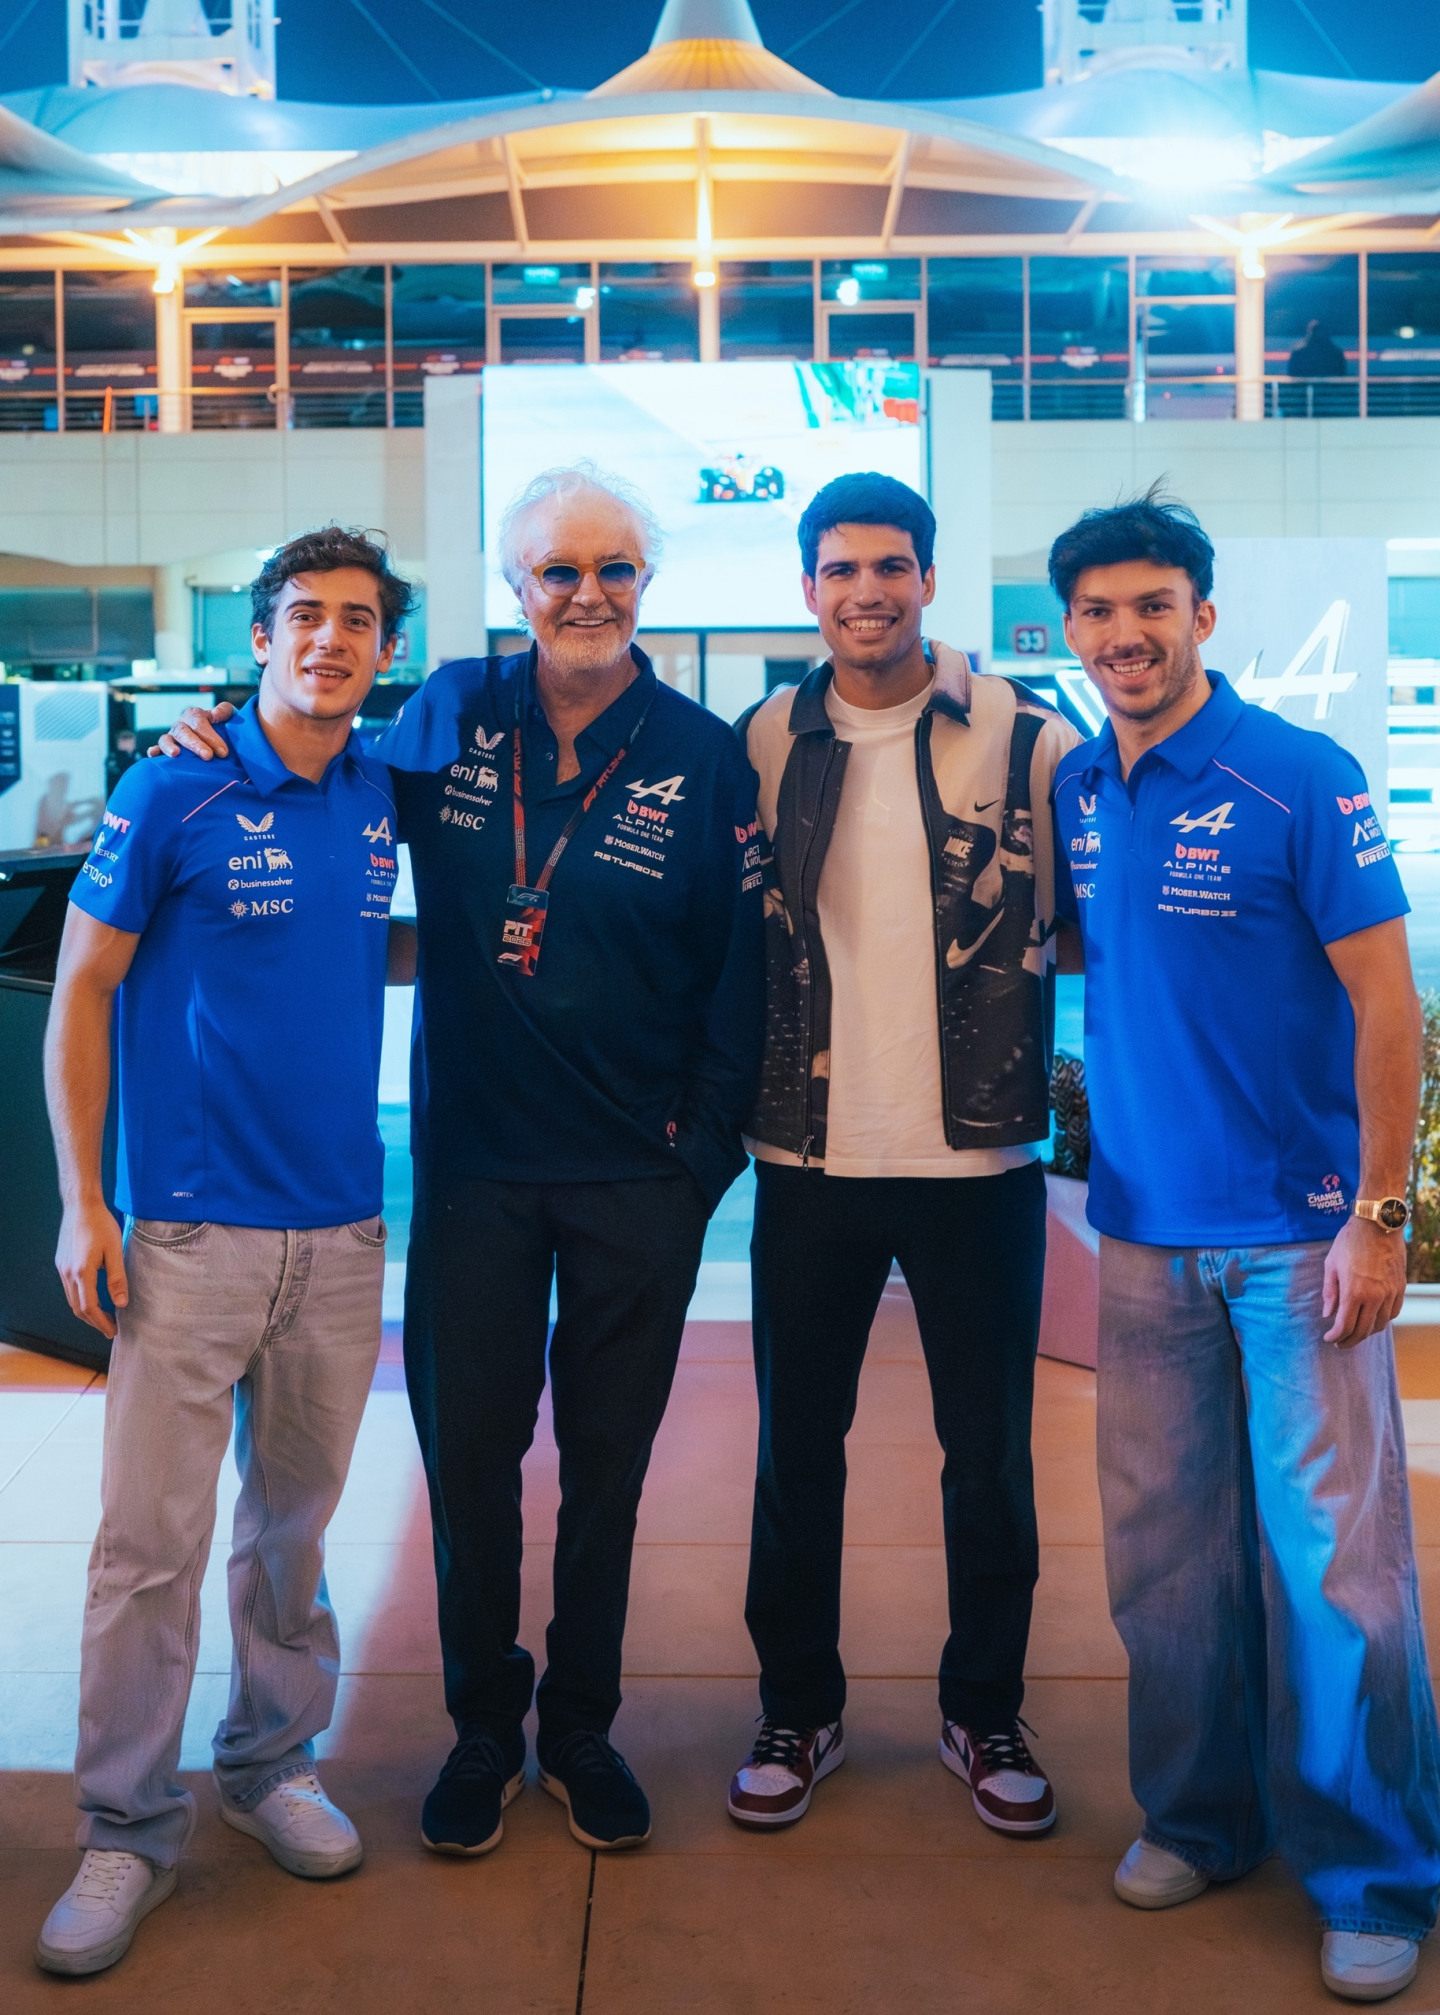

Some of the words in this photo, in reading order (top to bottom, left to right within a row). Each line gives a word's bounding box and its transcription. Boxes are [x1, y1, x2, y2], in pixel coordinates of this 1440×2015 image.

[450, 763, 478, 782] eni
[452, 787, 493, 807] businessolver
[450, 809, 485, 831] MSC
[639, 805, 669, 824] BWT
[612, 813, 675, 838] ALPINE
[1071, 834, 1087, 852] eni
[228, 851, 262, 871] eni
[1187, 847, 1220, 861] BWT
[365, 869, 396, 879] ALPIN
[1163, 860, 1231, 874] ALPINE
[241, 877, 294, 889] businessolver
[1075, 883, 1096, 898] MSC
[251, 899, 294, 916] MSC
[504, 920, 533, 937] PIT
[1308, 1190, 1343, 1204] CHANGE
[1316, 1197, 1345, 1210] WORLD
